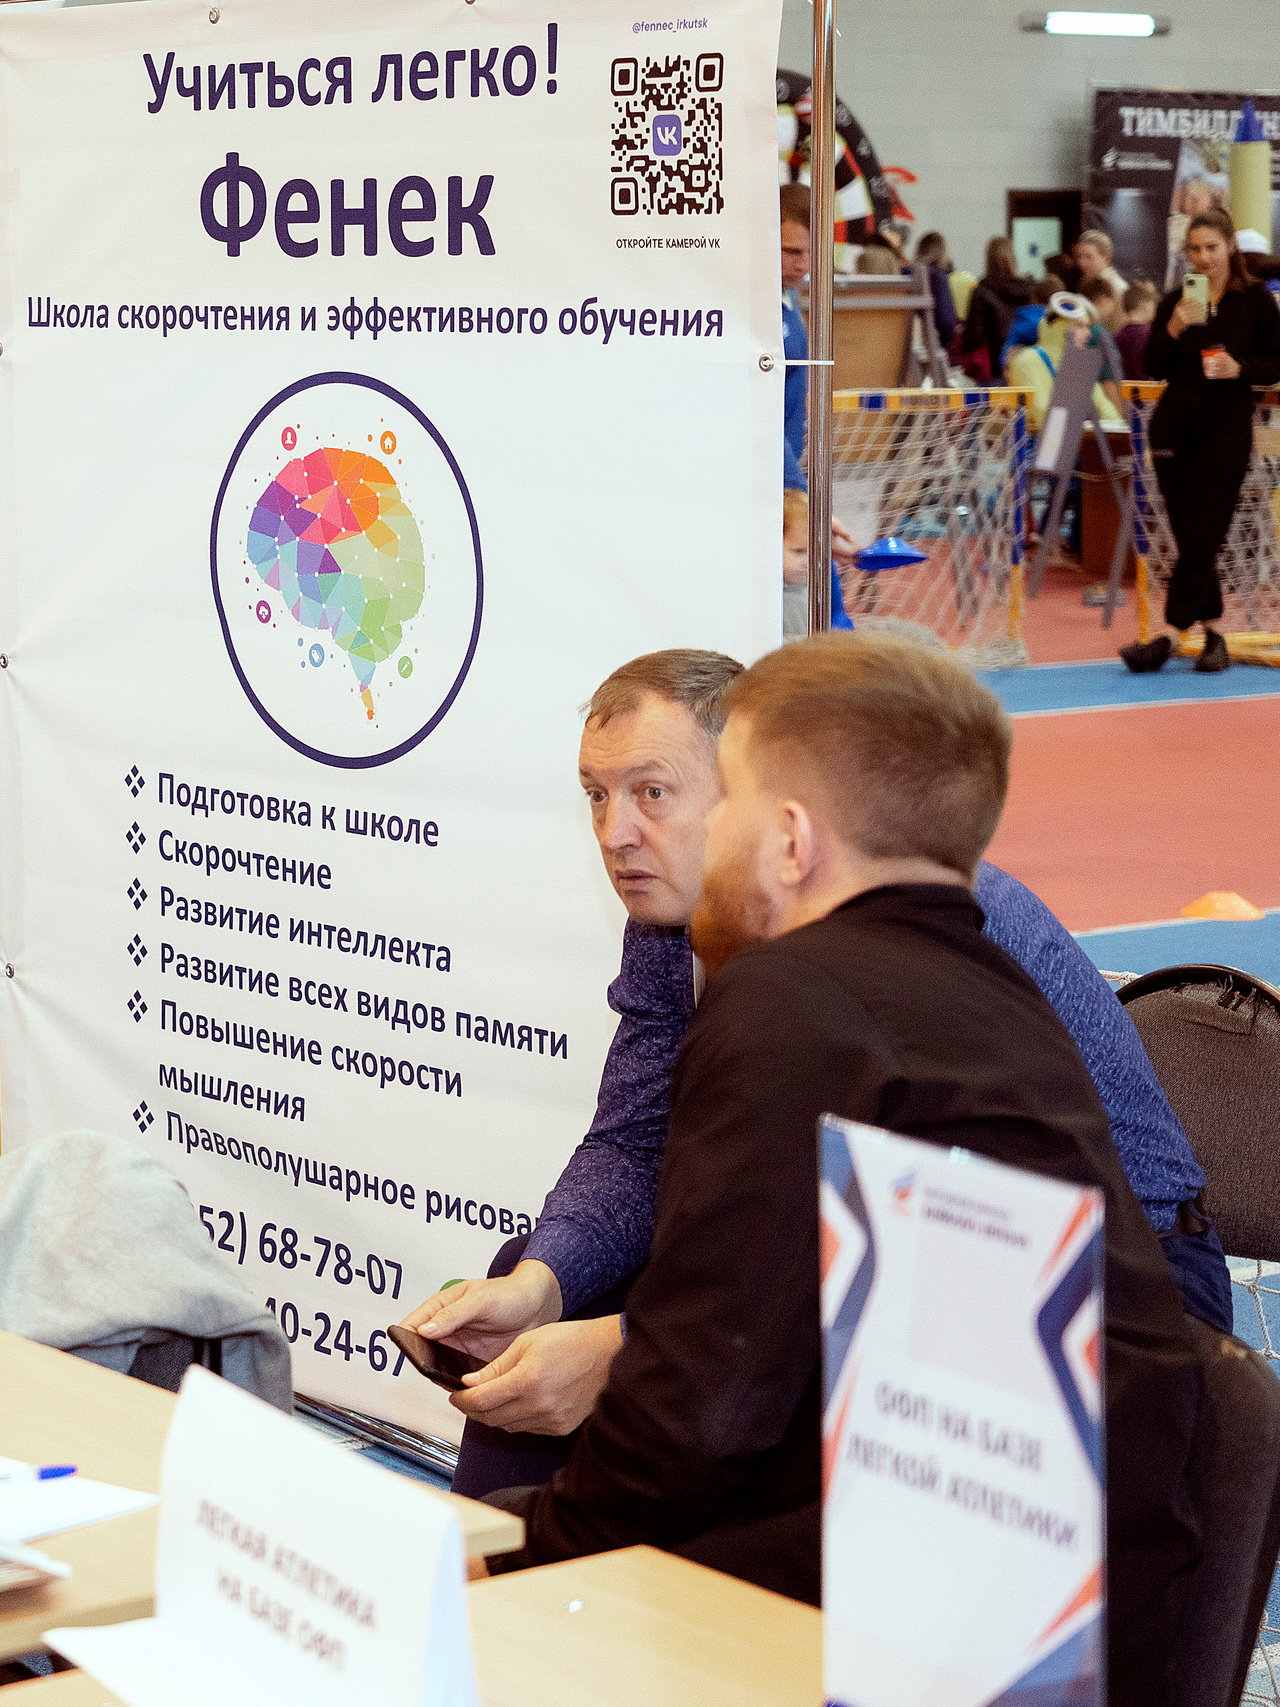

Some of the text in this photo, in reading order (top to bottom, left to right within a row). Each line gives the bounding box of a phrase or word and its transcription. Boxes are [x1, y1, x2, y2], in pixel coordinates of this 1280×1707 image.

[632, 17, 708, 34] @fennec_irkutsk
[142, 22, 558, 114] Учиться легко!
[200, 151, 496, 259] Фенек
[615, 236, 720, 249] ОТКРОЙТЕ КАМЕРОЙ VK
[27, 296, 723, 345] Школа скорочтения и эффективного обучения
[158, 772, 439, 847] Подготовка к школе
[158, 829, 332, 890] Скорочтение
[160, 885, 451, 973] Развитие интеллекта
[160, 942, 569, 1060] Развитие всех видов памяти
[161, 998, 462, 1098] Повышение скорости
[159, 1063, 305, 1122] мышления
[166, 1110, 541, 1238] Правополушарное рисова
[259, 1222, 403, 1300] 68-78-07
